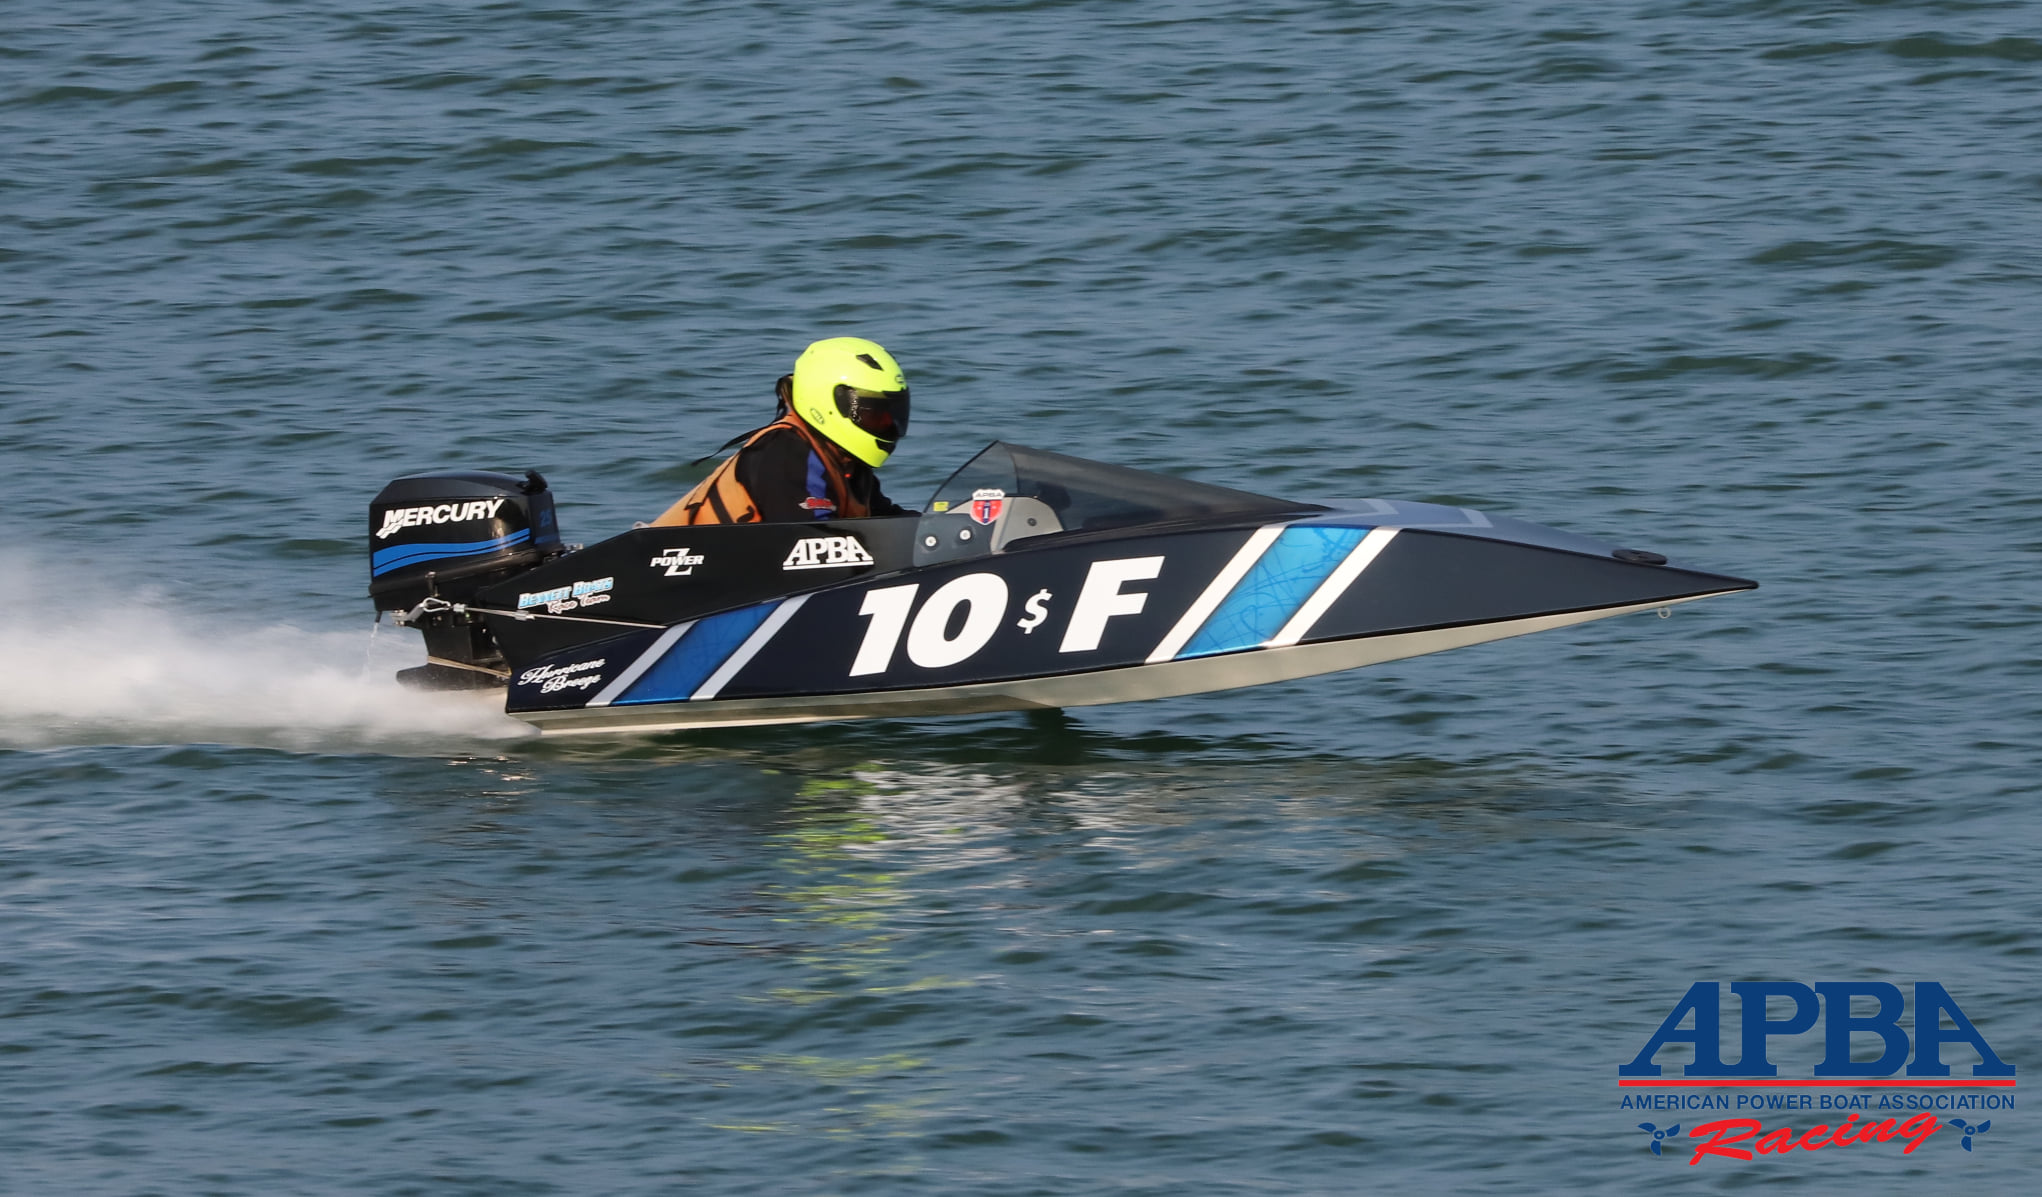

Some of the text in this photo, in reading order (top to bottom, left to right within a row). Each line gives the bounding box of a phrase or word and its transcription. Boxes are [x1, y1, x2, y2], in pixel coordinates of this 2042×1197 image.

[376, 499, 504, 539] MERCURY
[650, 555, 705, 567] POWER
[783, 536, 874, 565] APBA
[849, 556, 1165, 677] 10 $ F
[517, 659, 606, 685] Hurricane
[540, 675, 602, 693] Breeze
